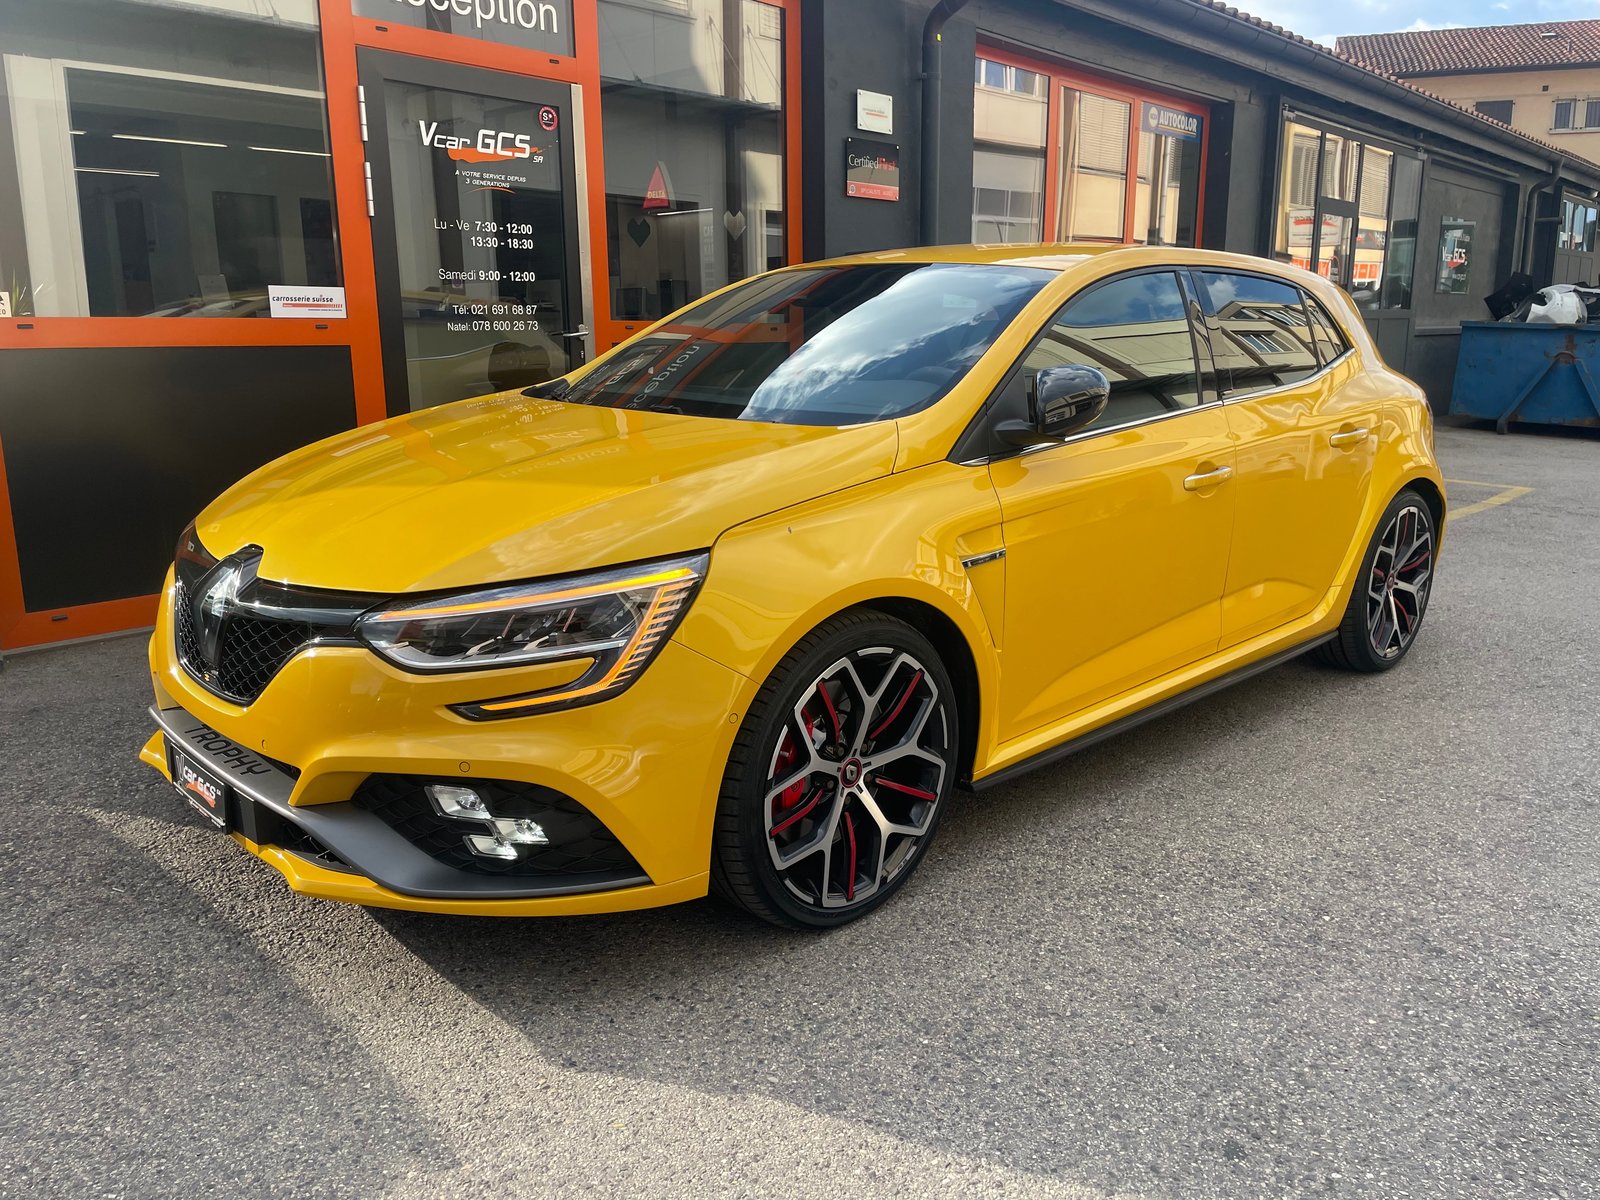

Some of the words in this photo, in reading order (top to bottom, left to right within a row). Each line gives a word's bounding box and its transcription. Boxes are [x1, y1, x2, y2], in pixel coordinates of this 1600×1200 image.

[396, 0, 558, 33] eption
[1159, 110, 1198, 132] AUTOCOLOR
[418, 120, 471, 150] Vcar
[476, 129, 531, 158] GCS
[848, 153, 879, 169] Certified
[461, 170, 481, 178] VOTRE
[482, 172, 506, 181] SERVICE
[507, 175, 527, 183] DEPUIS
[472, 179, 510, 188] GENERATIONS
[433, 218, 447, 230] Lu
[455, 219, 470, 231] Ve
[475, 221, 498, 233] 7:30
[505, 223, 533, 235] 12:00
[470, 236, 498, 248] 13:30
[507, 238, 534, 250] 18:30
[438, 268, 477, 281] Samedi
[479, 270, 501, 282] 9:00
[509, 271, 536, 283] 12:00
[272, 295, 311, 303] carrosserie
[312, 294, 334, 303] suisse
[471, 304, 488, 315] 021
[491, 304, 509, 315] 691
[511, 304, 524, 315] 68
[525, 304, 538, 315] 87
[447, 322, 471, 331] Natel:
[472, 320, 491, 331] 078
[493, 320, 511, 331] 600
[513, 320, 525, 331] 26
[527, 320, 539, 331] 73
[184, 723, 272, 776] TROPHY
[197, 774, 217, 800] GCS
